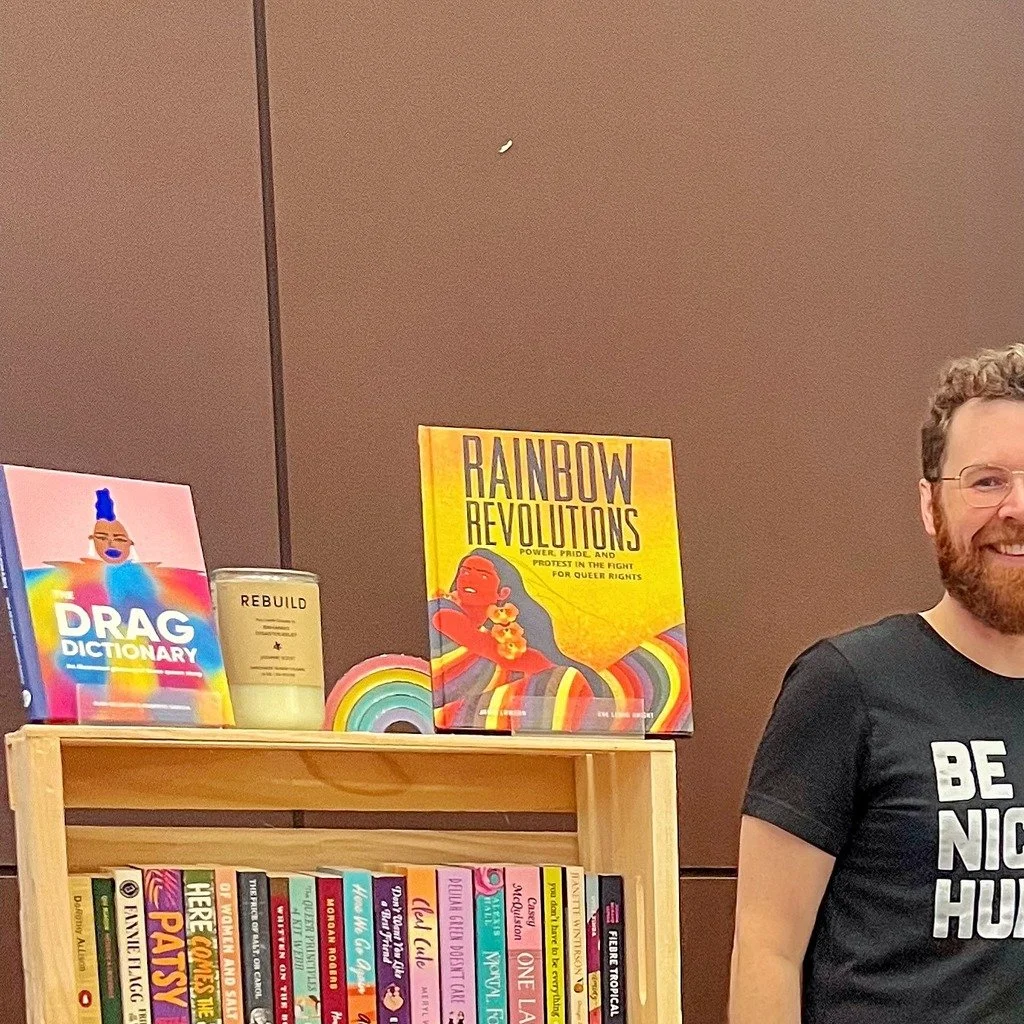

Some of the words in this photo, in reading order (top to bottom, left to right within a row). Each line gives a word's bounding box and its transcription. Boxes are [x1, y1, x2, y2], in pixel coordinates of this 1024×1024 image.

[463, 435, 633, 505] RAINBOW
[465, 500, 641, 551] REVOLUTIONS
[533, 559, 572, 568] PROTEST
[588, 561, 605, 569] THE
[608, 561, 633, 569] FIGHT
[574, 572, 606, 580] QUEER
[608, 573, 642, 581] RIGHTS
[241, 595, 307, 609] REBUILD
[55, 603, 195, 645] DRAG
[61, 640, 197, 664] DICTIONARY
[930, 740, 1014, 802] BE
[219, 883, 231, 898] OF
[448, 878, 464, 911] DELILAH
[548, 882, 558, 898] you
[186, 882, 212, 933] HERE
[510, 883, 524, 941] McQuiston
[524, 897, 539, 928] Casey
[550, 900, 561, 923] don't
[123, 905, 141, 954] FANNIE
[220, 904, 235, 952] WOMEN
[276, 906, 287, 959] WRITTEN
[449, 915, 466, 941] GREEN
[551, 925, 560, 945] have
[148, 911, 187, 1008] PATSY
[449, 945, 466, 980] DOESN'T
[552, 947, 560, 956] to
[552, 958, 561, 968] be
[607, 930, 619, 966] FIEBRE
[127, 958, 143, 1003] FLAGG
[190, 936, 216, 994] COMES
[224, 959, 236, 987] AND
[279, 964, 287, 980] ON
[516, 952, 535, 991] ONE
[226, 991, 238, 1020] SALT
[280, 986, 289, 1009] THE
[420, 986, 431, 1017] MERYL
[450, 983, 467, 1005] CARE
[549, 970, 563, 1018] everything
[608, 967, 620, 1017] TROPICAL
[197, 997, 216, 1019] THE
